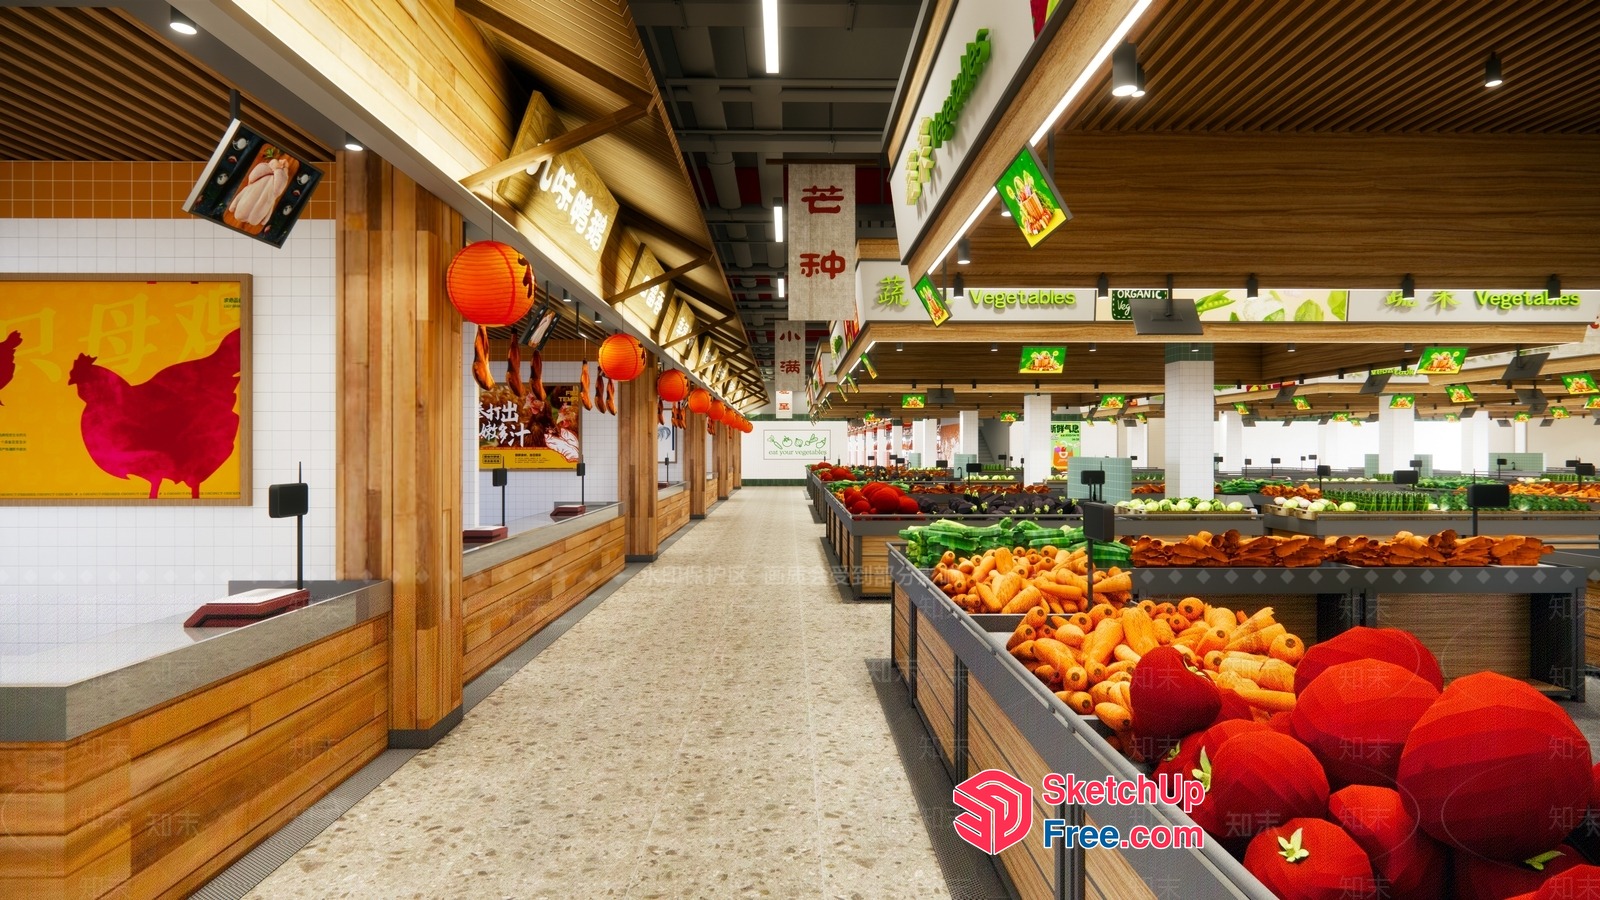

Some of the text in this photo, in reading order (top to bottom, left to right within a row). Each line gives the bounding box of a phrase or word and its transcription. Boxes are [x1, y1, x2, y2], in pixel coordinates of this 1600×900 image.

[800, 185, 846, 279] 芒种
[968, 289, 1077, 309] Vegetables
[1117, 290, 1163, 300] ORGANIC
[779, 330, 801, 375] 小满
[795, 449, 828, 457] vegetables
